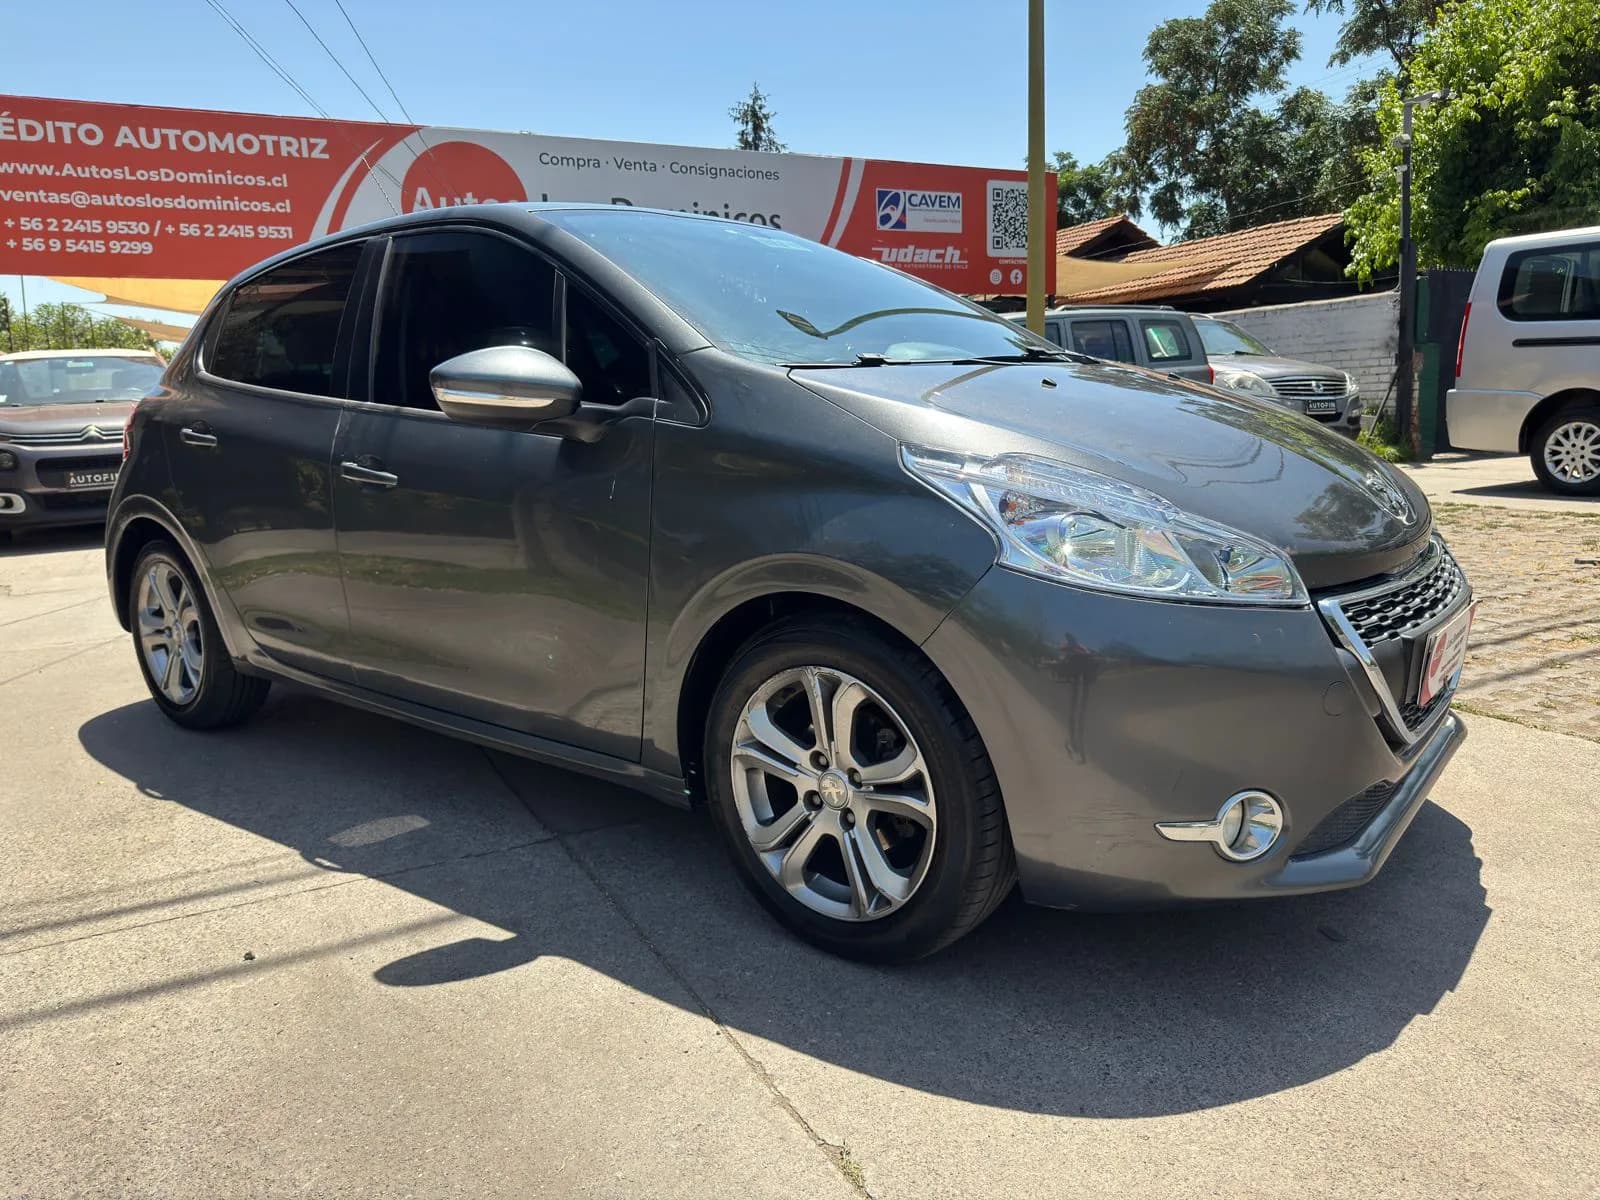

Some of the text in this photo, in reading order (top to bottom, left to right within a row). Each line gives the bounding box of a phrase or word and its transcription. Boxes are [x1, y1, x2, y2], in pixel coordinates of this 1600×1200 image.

[114, 125, 330, 160] AUTOMOTRIZ
[0, 162, 288, 188] www.AutosLosDominicos.cl
[538, 152, 601, 170] Compra
[613, 157, 657, 173] Venta
[669, 162, 780, 181] Consignaciones
[0, 189, 291, 213] ventas@autoslosdominicos.cl
[908, 193, 960, 209] CAVEM
[20, 217, 43, 231] 56
[47, 218, 59, 232] 2
[62, 219, 103, 233] 2415
[106, 220, 150, 235] 9530
[180, 223, 201, 237] 56
[203, 224, 215, 237] 2
[218, 224, 255, 238] 2415
[257, 225, 293, 239] 9531
[22, 238, 46, 251] 56
[49, 238, 61, 252] 9
[65, 239, 106, 253] 5415
[109, 241, 153, 255] 9299
